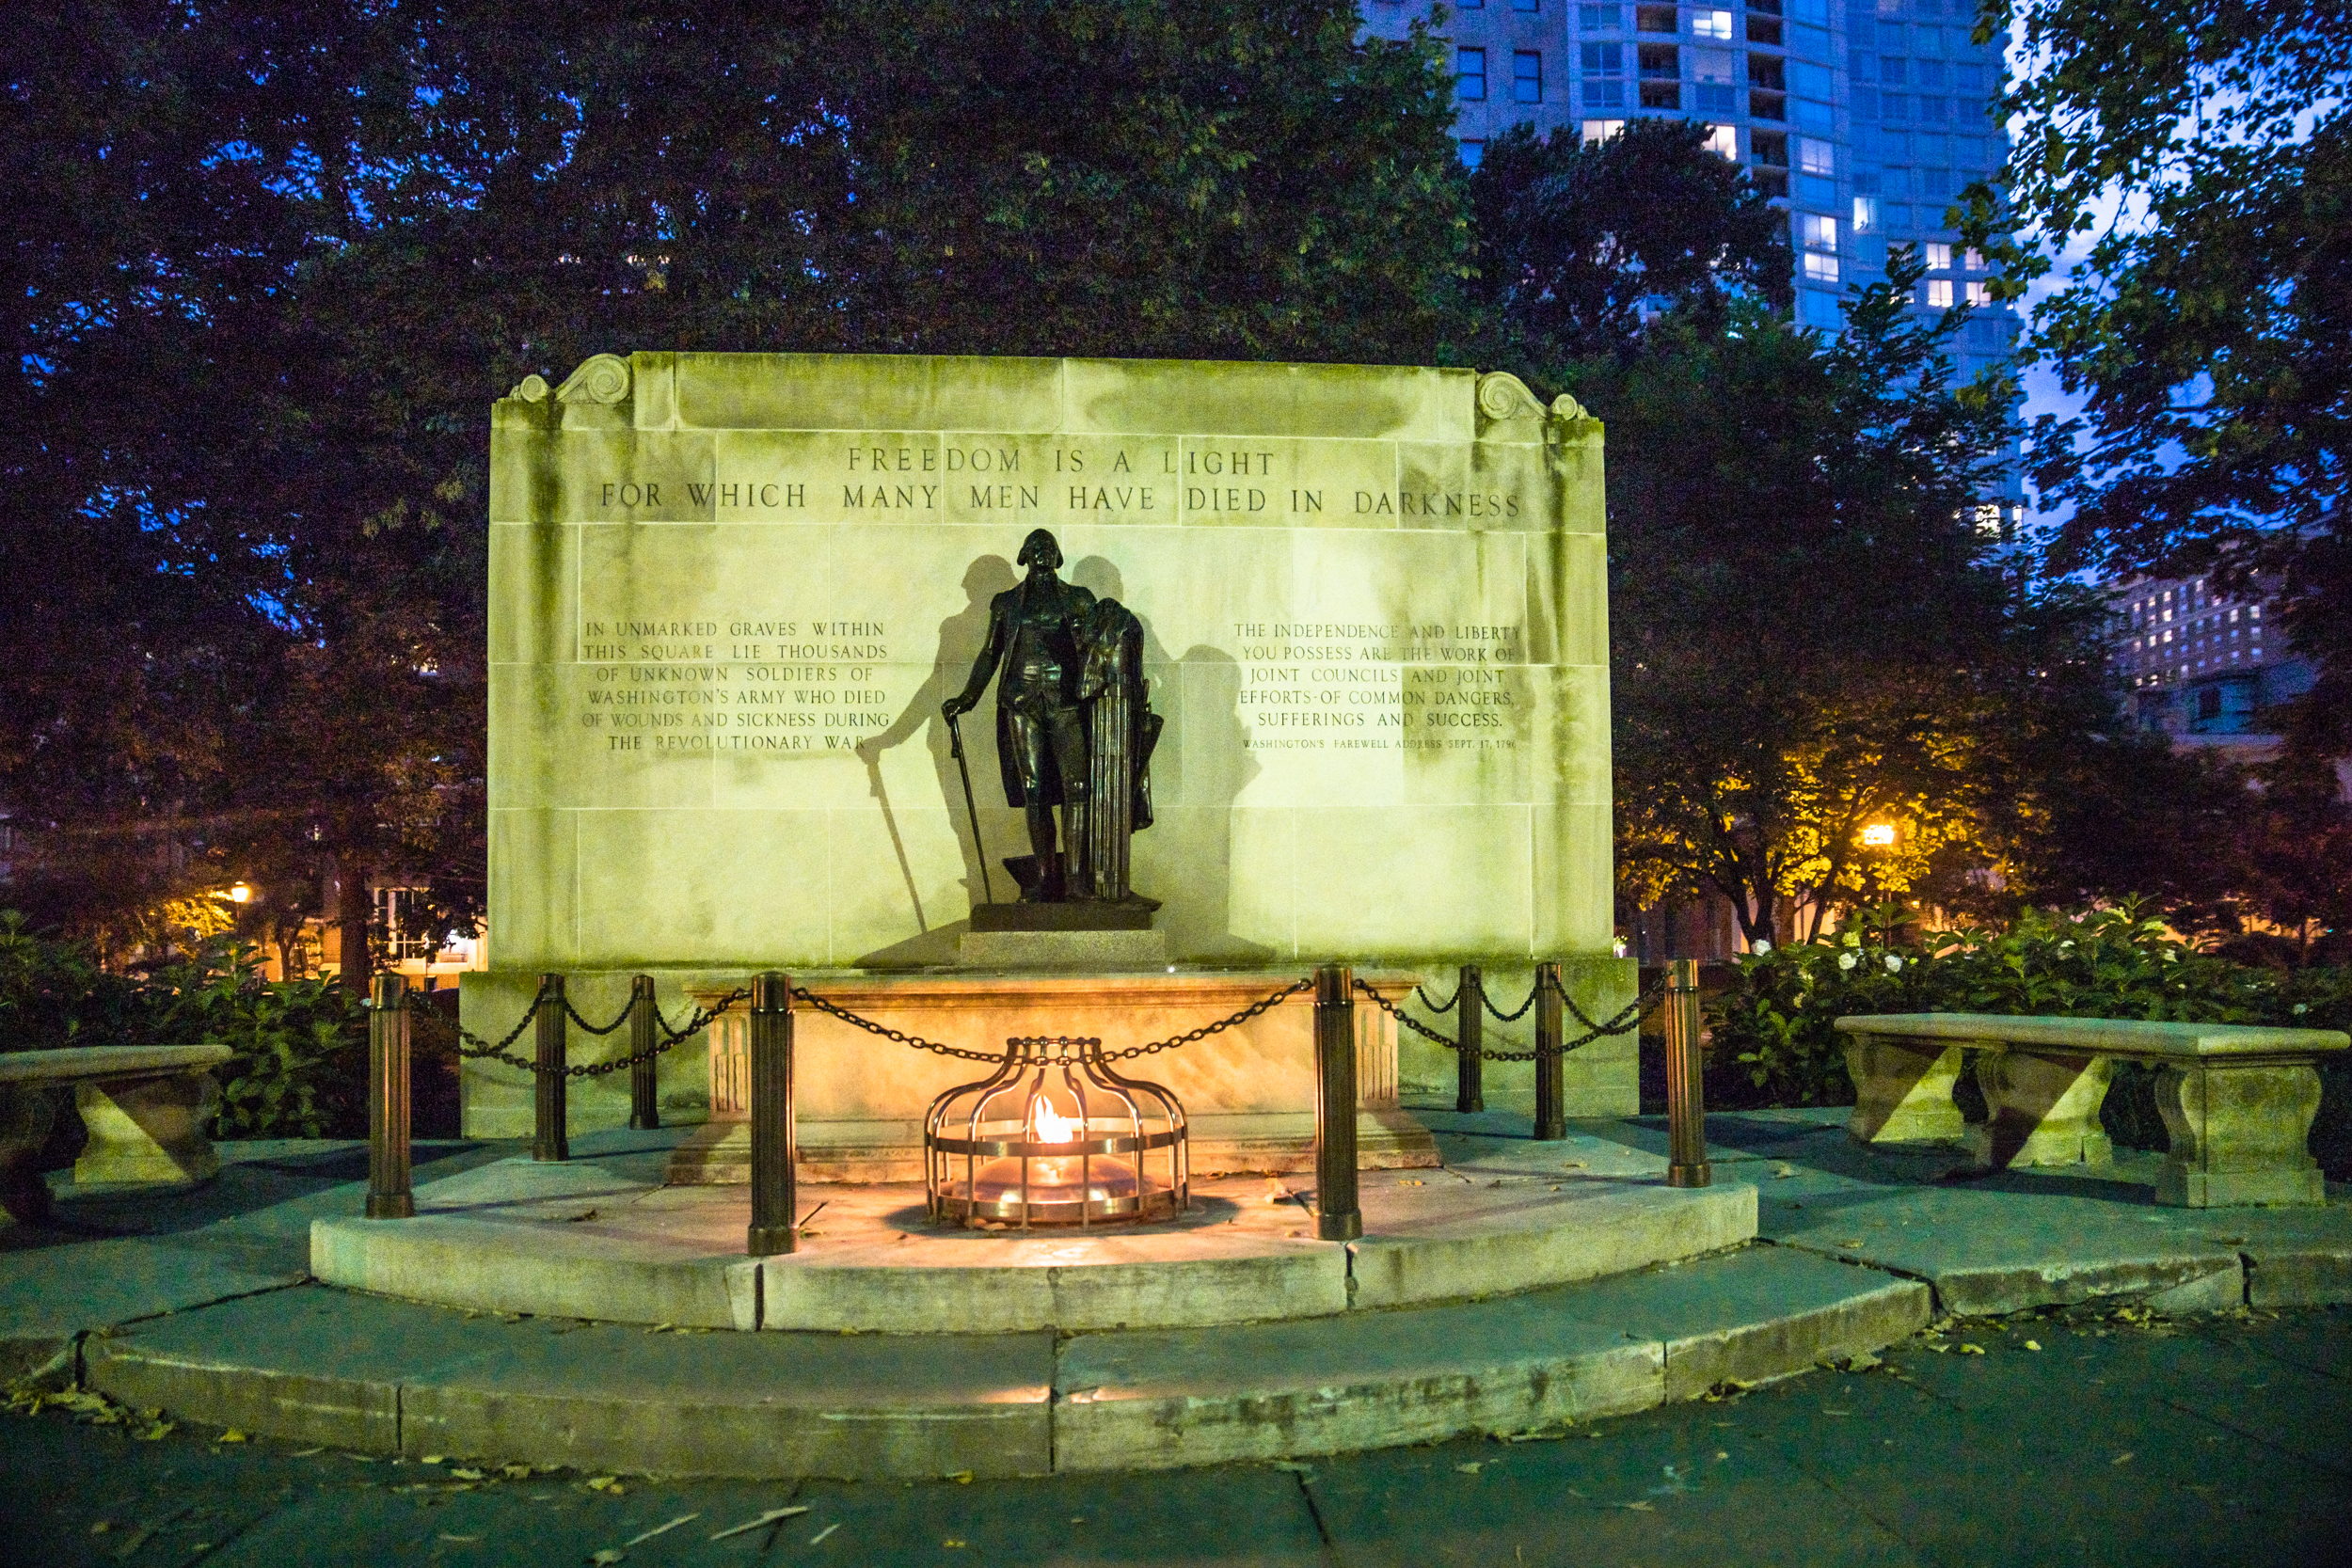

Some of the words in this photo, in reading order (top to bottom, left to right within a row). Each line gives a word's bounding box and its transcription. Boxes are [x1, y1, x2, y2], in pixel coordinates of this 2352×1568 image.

[848, 447, 1021, 472] FREEDOM
[1055, 449, 1084, 472] IS
[1112, 450, 1132, 473] A
[1163, 451, 1274, 476] LIGHT
[600, 483, 662, 508] FOR
[687, 483, 805, 508] WHICH
[842, 484, 938, 509] MANY
[970, 485, 1040, 509] MEN
[1069, 486, 1154, 511] HAVE
[1187, 486, 1266, 513] DIED
[1291, 489, 1324, 514] IN
[1354, 490, 1519, 517] DARKNESS
[585, 622, 605, 637] IN
[616, 622, 718, 637] UNMARKED
[729, 622, 797, 637] GRAVES
[812, 622, 883, 637] WITHIN
[1233, 623, 1266, 638] THE
[1274, 623, 1399, 639] INDEPENDENCE
[1410, 625, 1445, 640] AND
[1455, 626, 1520, 641] LIBERTY
[583, 644, 627, 659] THIS
[641, 644, 714, 661] SQUARE
[732, 644, 761, 659] LIE
[777, 644, 887, 659] THOUSANDS
[1243, 645, 1277, 660] YOU
[1284, 645, 1352, 660] POSSESS
[1359, 647, 1391, 660] ARE
[1400, 647, 1432, 661] THE
[1440, 647, 1487, 662] WORK
[1495, 648, 1518, 662] OF
[596, 667, 619, 682] OF
[630, 667, 728, 682] UNKNOWN
[746, 667, 837, 682] SOLDIERS
[850, 667, 873, 682] OF
[1250, 668, 1300, 685] JOINT
[1311, 668, 1398, 683] COUNCILS
[1411, 670, 1447, 683] AND
[1456, 670, 1505, 686] JOINT
[587, 689, 729, 705] WASHINGTON'S
[737, 689, 786, 705] ARMY
[794, 689, 835, 705] WHO
[844, 689, 885, 705] DIED
[1348, 690, 1425, 705] COMMON
[1435, 691, 1515, 706] DANGERS,
[581, 713, 603, 727] OF
[612, 713, 684, 727] WOUNDS
[691, 713, 728, 727] AND
[737, 713, 816, 727] SICKNESS
[824, 712, 889, 727] DURING
[1258, 712, 1365, 726] SUFFERINGS
[1376, 713, 1414, 727] AND
[1426, 713, 1502, 727] SUCCESS.
[608, 736, 643, 751] THE
[656, 736, 813, 750] REVOLUTIONARY
[824, 736, 865, 750] WAR
[1243, 738, 1325, 749] WASHINGTON'S
[1333, 739, 1389, 749] FAREWELL
[1394, 739, 1442, 749] ADDRESS
[1448, 739, 1475, 749] SEPT.
[1480, 739, 1492, 751] 17,
